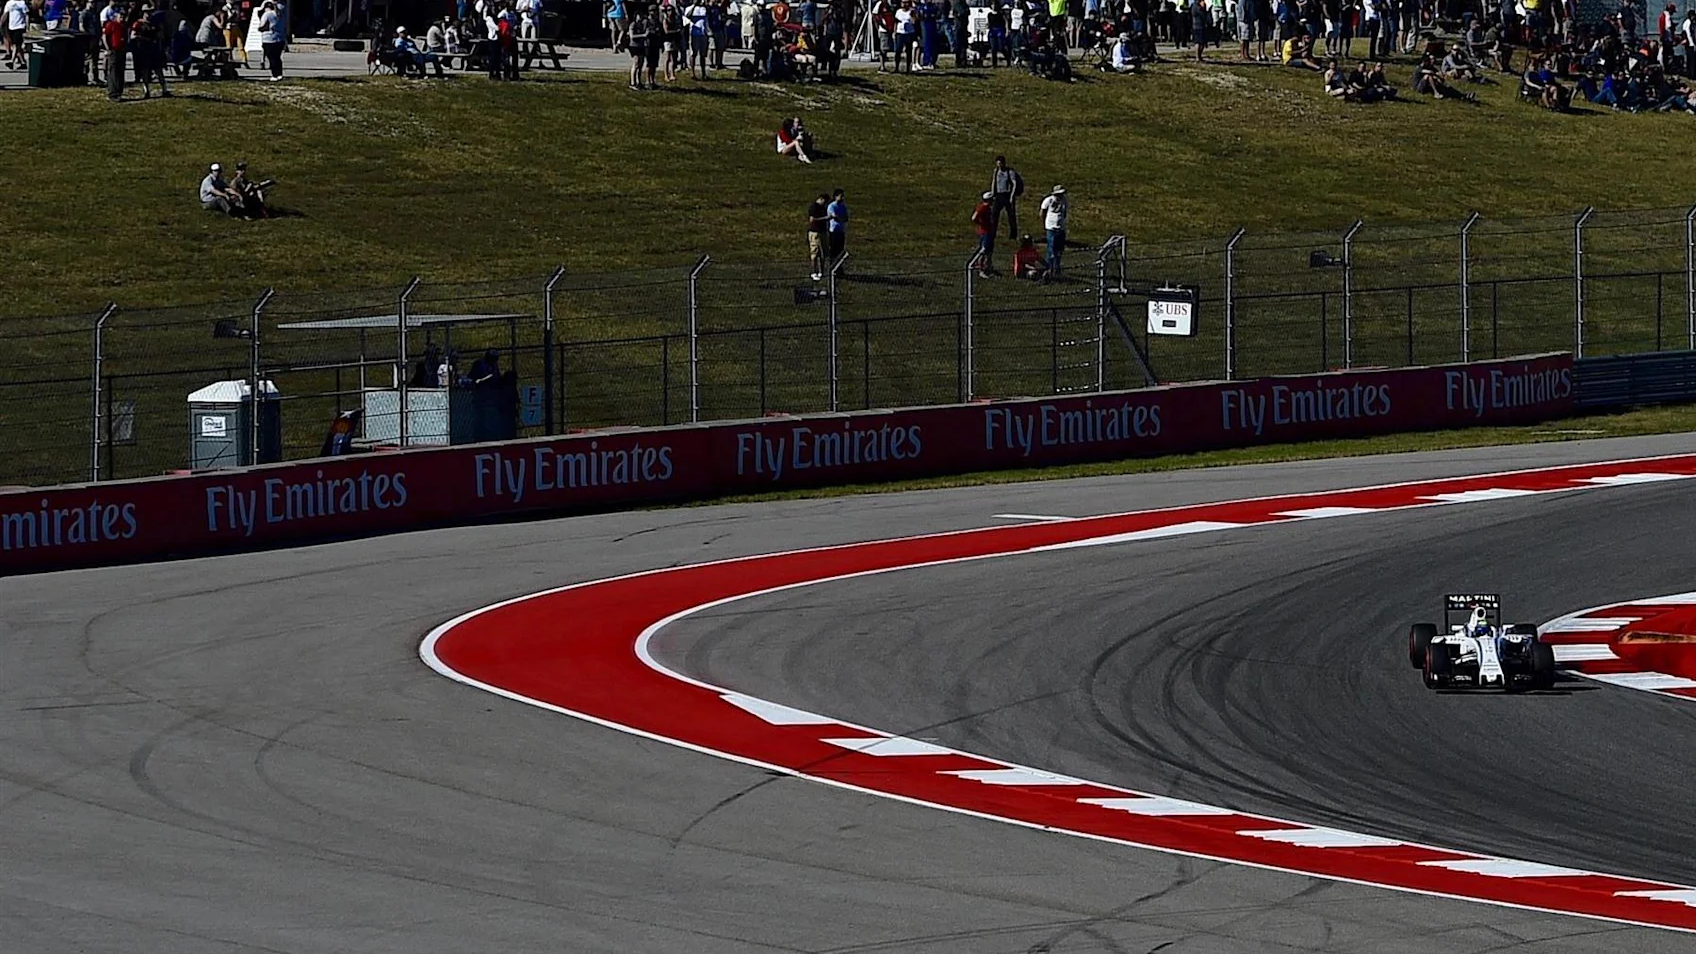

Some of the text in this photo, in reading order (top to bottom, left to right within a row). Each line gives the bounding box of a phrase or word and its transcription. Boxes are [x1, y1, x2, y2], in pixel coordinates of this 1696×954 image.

[1166, 303, 1188, 316] UBS
[1221, 379, 1392, 437] Fly Emirates
[1443, 365, 1571, 418] Fly Emirates
[736, 421, 923, 481] Fly Emirates
[984, 398, 1162, 457] Fly Emirates
[474, 440, 673, 503] Fly Emirates
[205, 469, 408, 537] Fly Emirates
